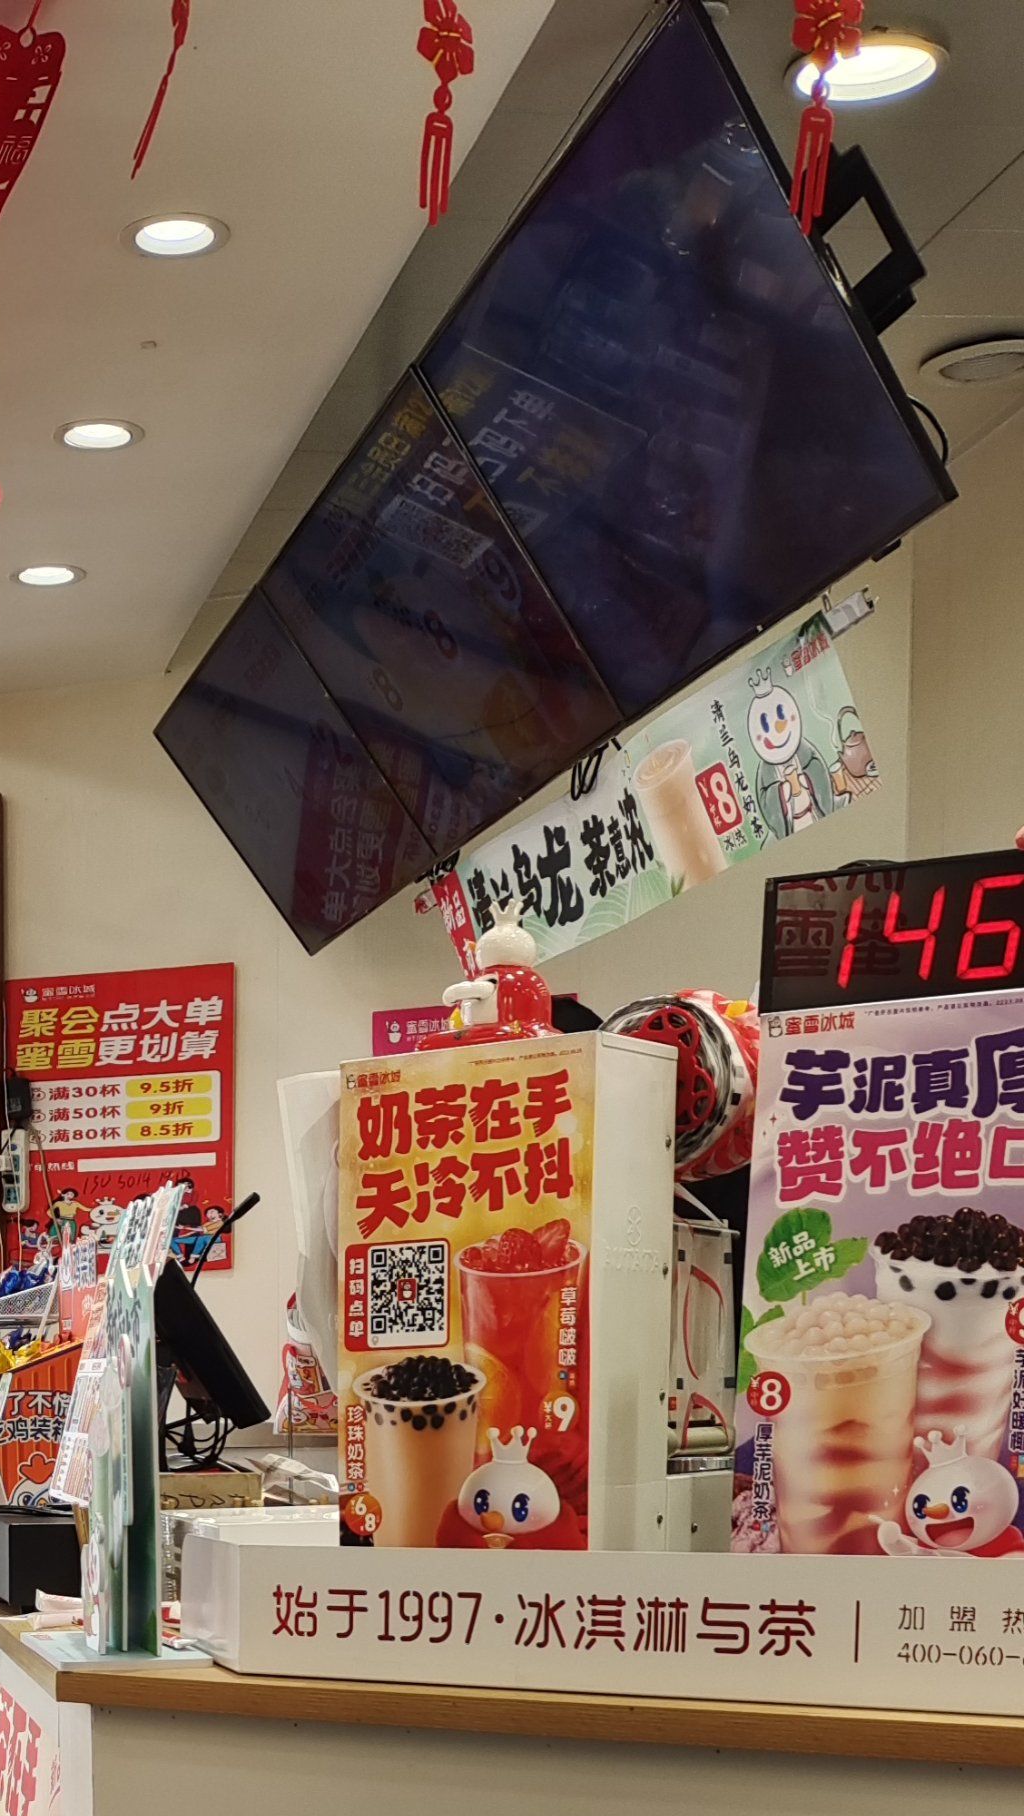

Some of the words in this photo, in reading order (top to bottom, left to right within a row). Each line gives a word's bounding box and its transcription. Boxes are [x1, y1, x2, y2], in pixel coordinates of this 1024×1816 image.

[837, 873, 1024, 990] 146
[15, 1029, 220, 1073] 蜜雪更划算
[18, 995, 224, 1039] 聚会点大单
[784, 1011, 856, 1036] 蜜雪冰城
[48, 1083, 121, 1102] 满30杯
[139, 1078, 195, 1096] 9.5折
[48, 1104, 121, 1123] 满50杯
[149, 1100, 185, 1116] 9折
[779, 1028, 1024, 1121] 芋泥真厚
[48, 1127, 121, 1144] 满80杯
[139, 1121, 195, 1138] 8.5折
[357, 1068, 573, 1161] 奶茶在手
[356, 1137, 574, 1240] 天冷不抖
[777, 1118, 1024, 1203] 赞不绝口
[768, 1231, 816, 1269] 新品
[793, 1246, 836, 1281] 上市
[348, 1257, 365, 1339] 扫码点单
[558, 1287, 577, 1366] 草莓啵啵
[347, 1405, 365, 1480] 珍珠奶茶
[753, 1423, 773, 1520] 厚芋泥奶茶
[272, 1584, 817, 1658] 始于1997·冰淇淋与茶
[896, 1642, 1024, 1666] 400-060-
